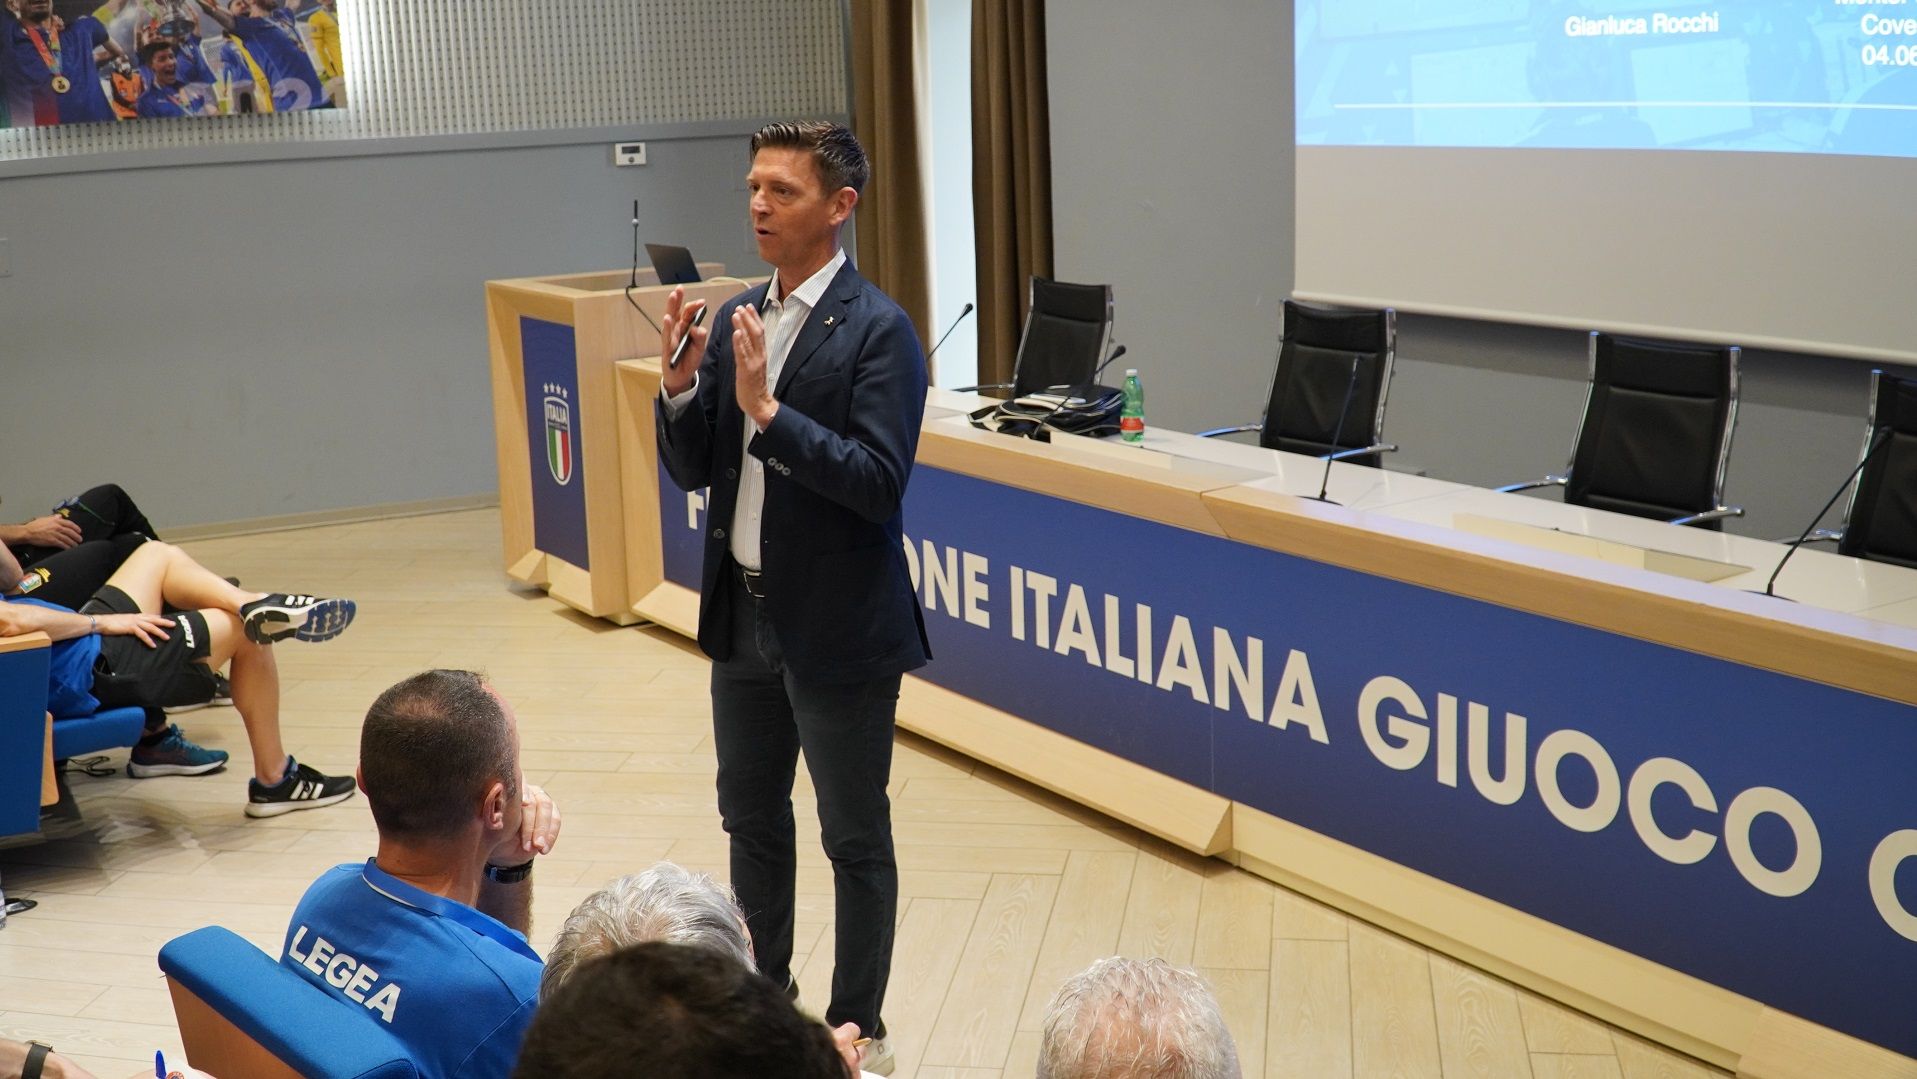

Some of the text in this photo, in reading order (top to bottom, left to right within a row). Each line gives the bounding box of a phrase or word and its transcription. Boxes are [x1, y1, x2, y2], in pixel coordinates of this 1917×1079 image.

[1565, 11, 1719, 36] Gianluca Rocchi
[1861, 13, 1917, 36] Cove
[1010, 566, 1329, 745] ITALIANA
[1358, 675, 1822, 897] GIUOCO
[288, 925, 401, 1024] LEGEA
